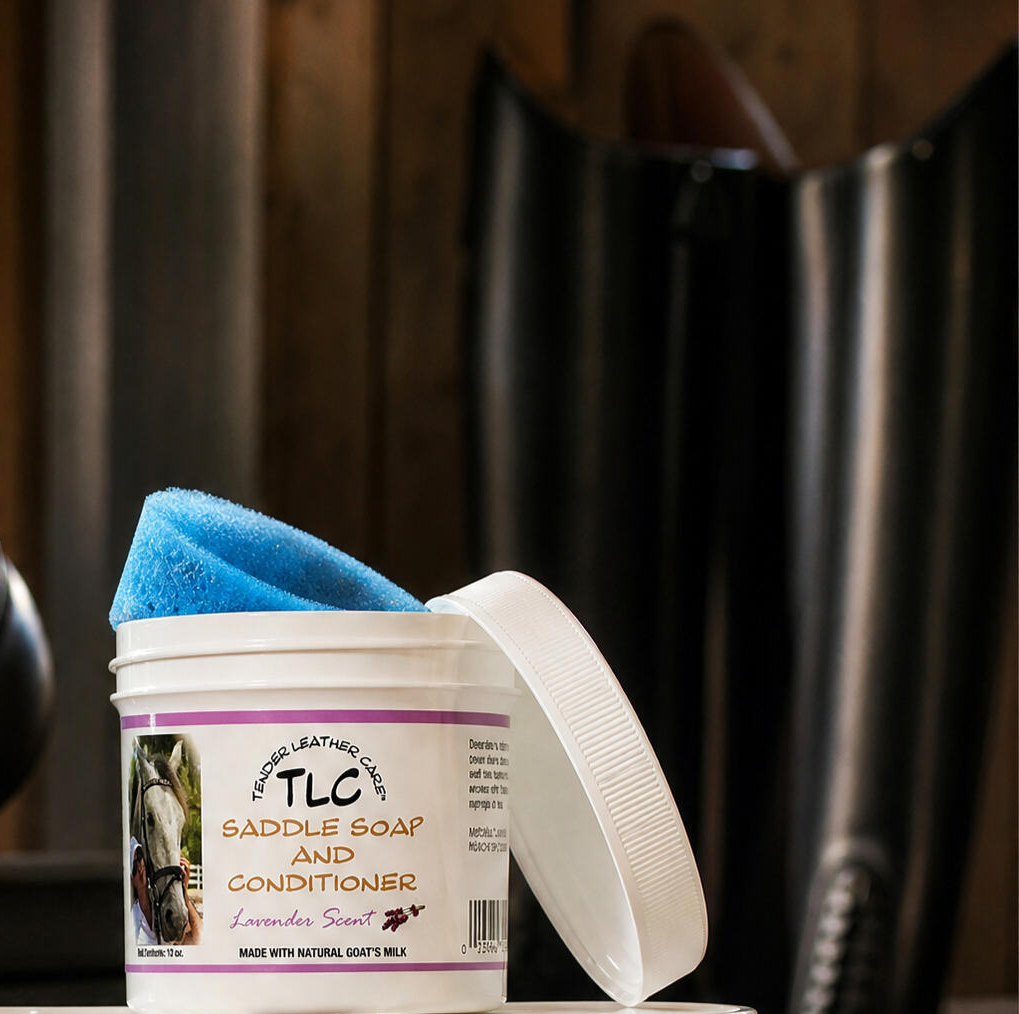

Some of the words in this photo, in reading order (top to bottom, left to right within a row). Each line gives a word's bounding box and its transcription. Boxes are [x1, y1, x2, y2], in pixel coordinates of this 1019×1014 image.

[252, 746, 290, 801] TENDER
[291, 736, 359, 758] LEATHER
[276, 768, 361, 807] TLC
[223, 818, 339, 839] SADDLE
[351, 816, 424, 837] SOAP
[291, 846, 354, 866] AND
[228, 873, 417, 892] CONDITIONER
[230, 908, 314, 929] Lavender
[323, 908, 377, 928] Scent
[240, 948, 267, 958] MADE
[269, 948, 294, 958] WITH
[298, 948, 343, 957] NATURAL
[346, 947, 381, 957] GOAT'S
[384, 947, 406, 957] MILK
